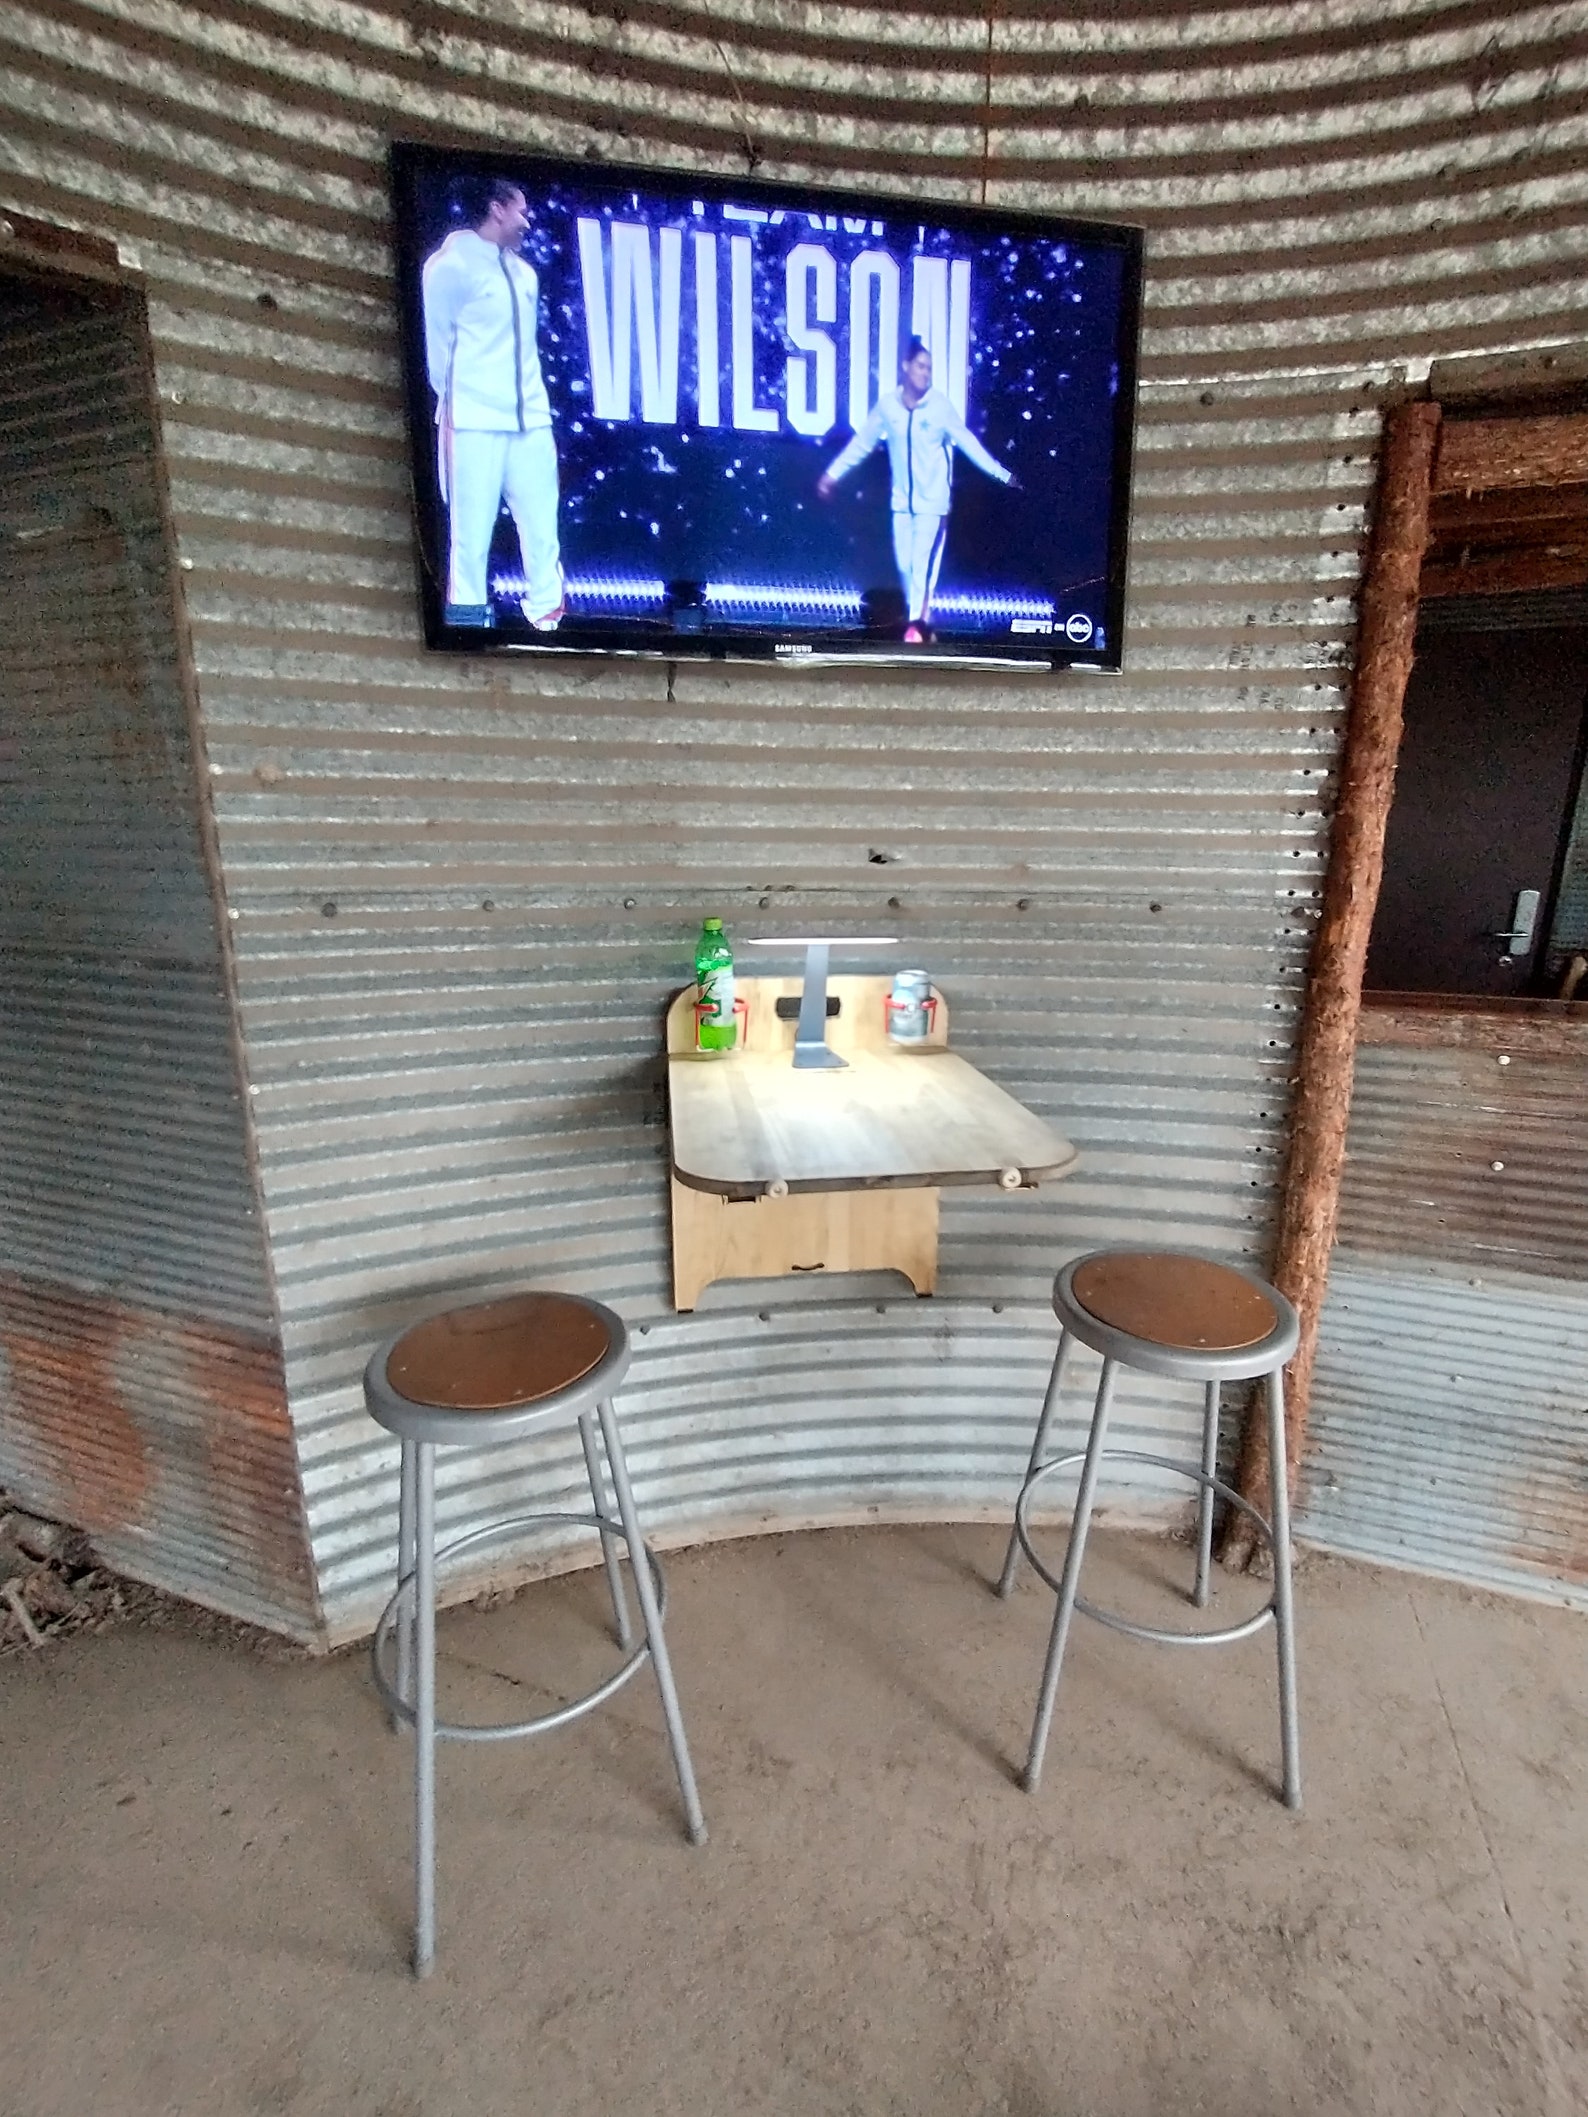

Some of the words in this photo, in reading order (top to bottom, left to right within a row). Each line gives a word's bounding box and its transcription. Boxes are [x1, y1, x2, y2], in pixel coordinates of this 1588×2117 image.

[577, 217, 971, 436] WILSON
[1068, 621, 1090, 633] abc
[774, 644, 812, 653] SAMSUNG
